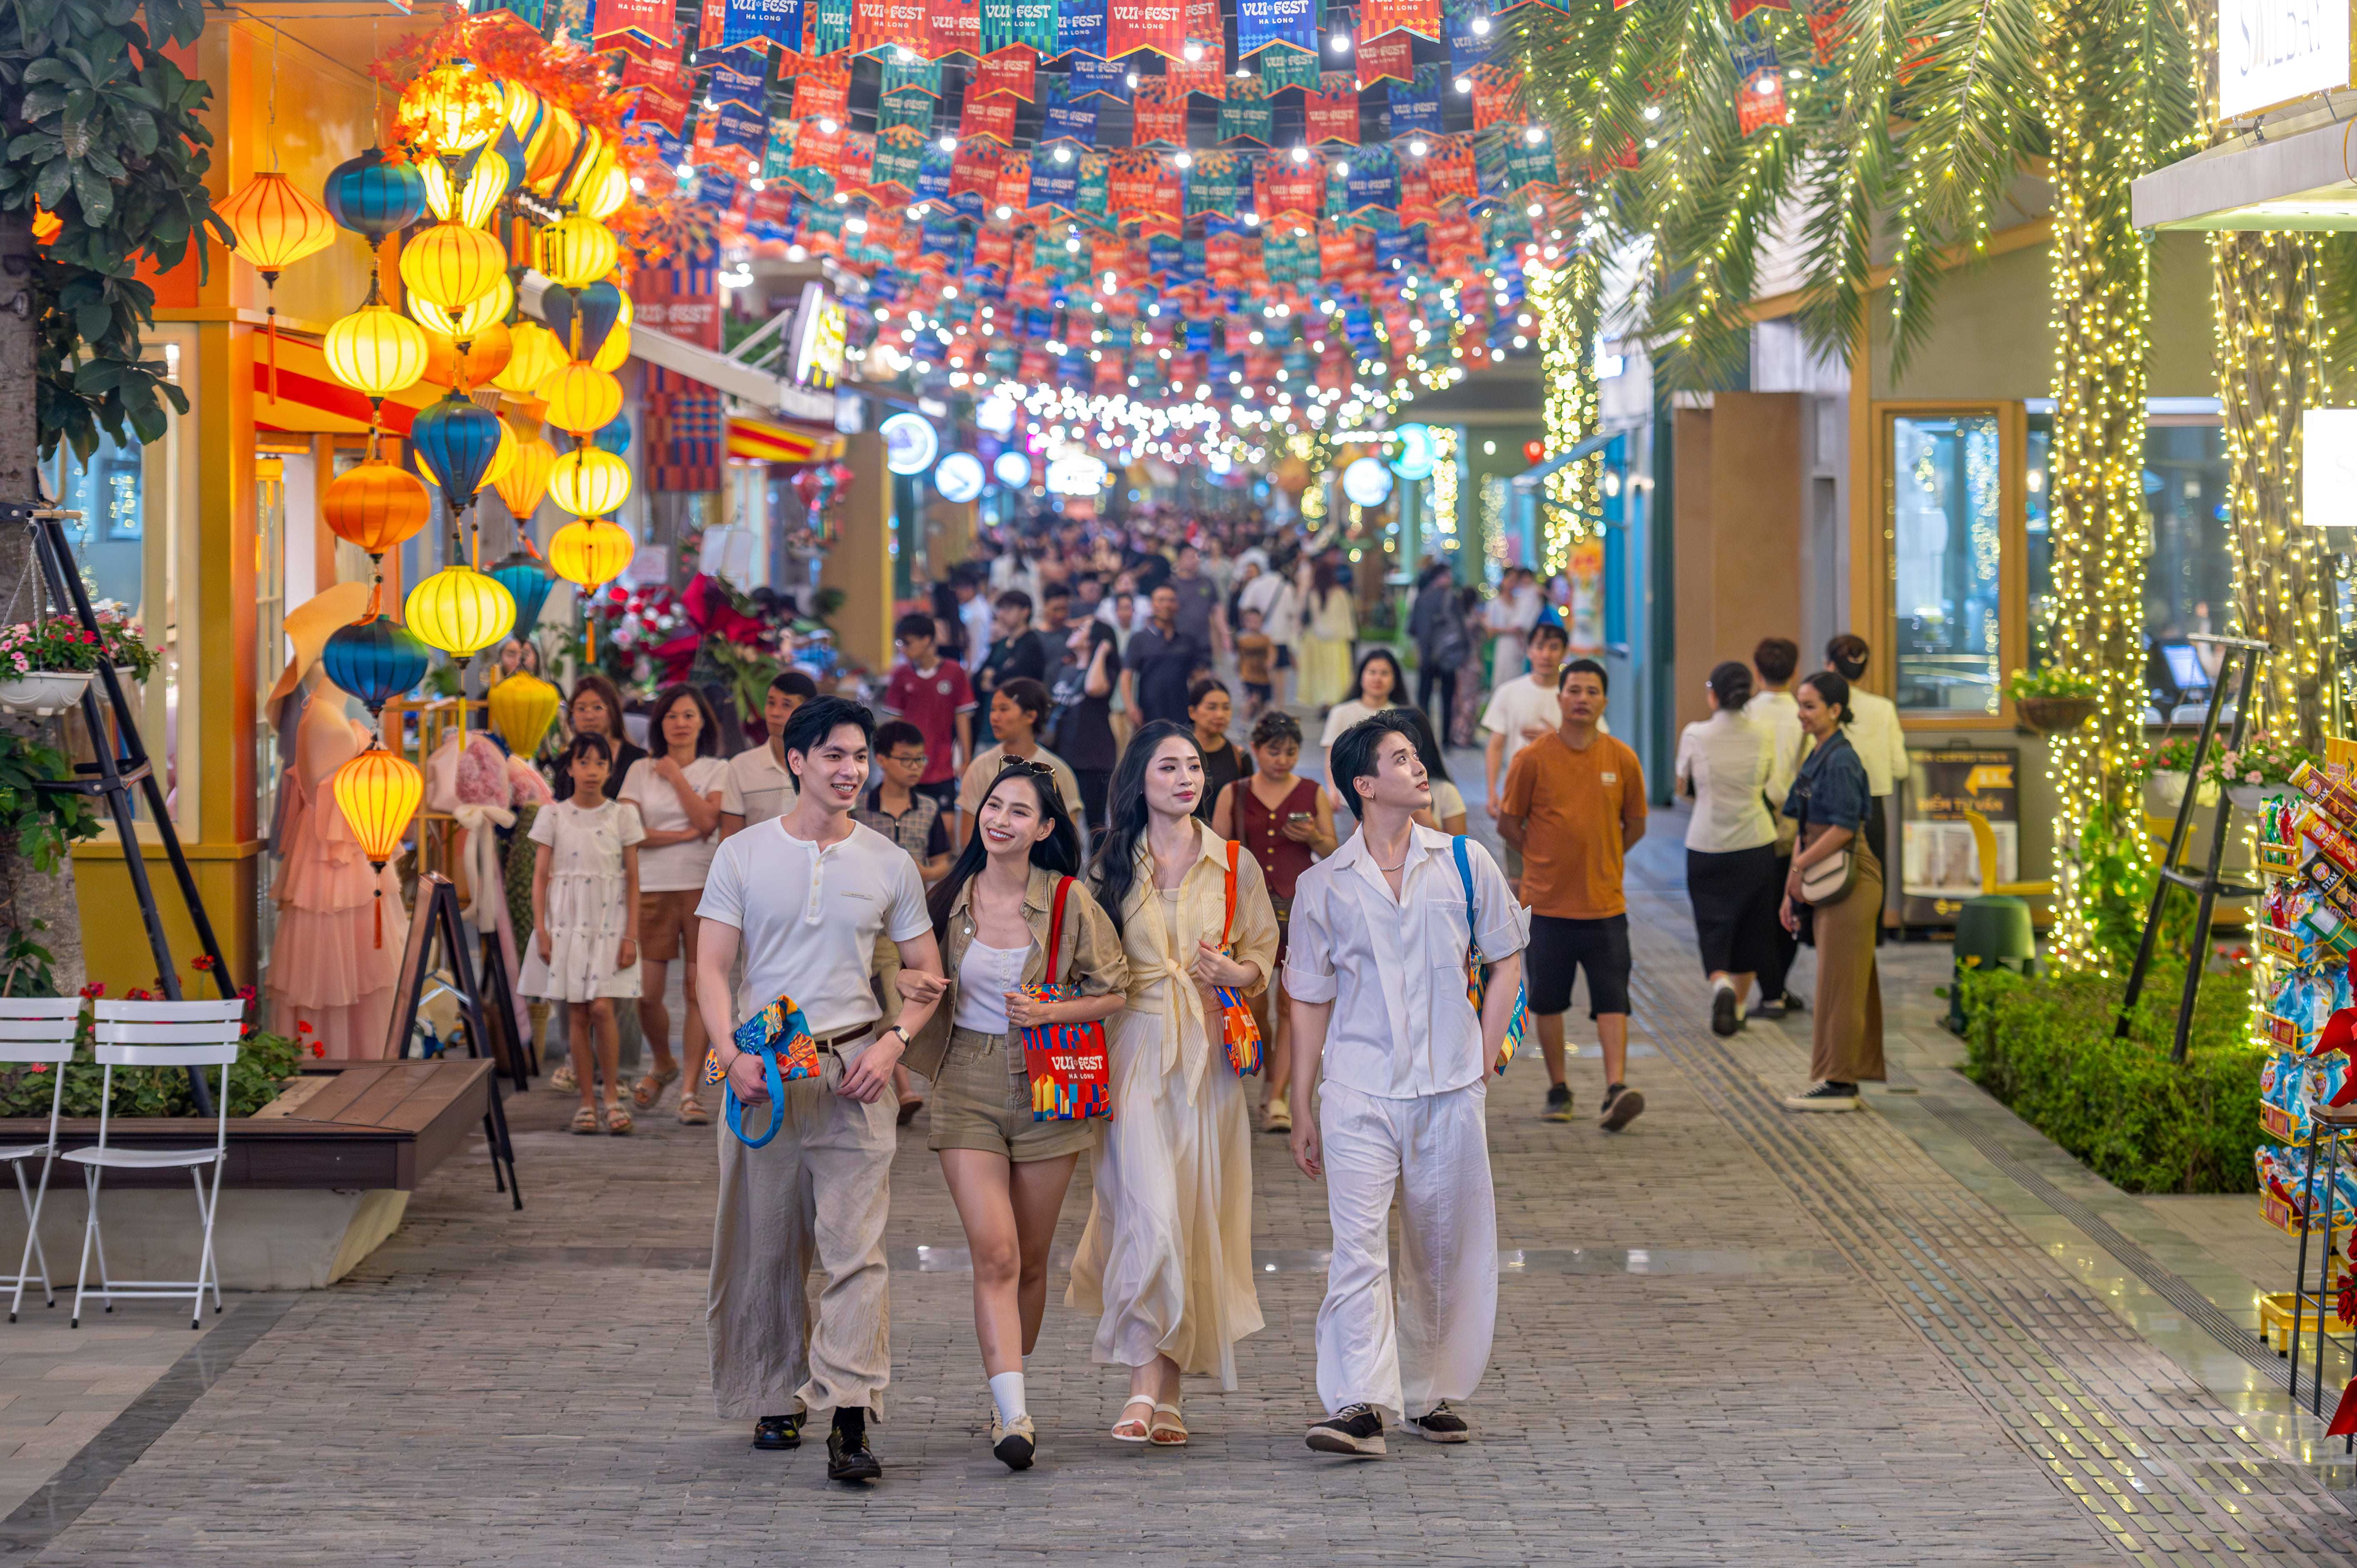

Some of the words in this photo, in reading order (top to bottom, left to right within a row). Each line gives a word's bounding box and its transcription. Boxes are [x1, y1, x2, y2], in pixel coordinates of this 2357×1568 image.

[708, 5, 725, 17] VU
[761, 0, 798, 13] FEST
[859, 3, 884, 18] VUI
[891, 6, 926, 20] FEST
[985, 5, 1010, 18] VUI
[1016, 5, 1051, 18] FEST
[1242, 2, 1267, 16] VUI
[1273, 0, 1309, 14] FEST
[821, 13, 843, 25] VUI
[1114, 7, 1138, 20] VUI
[1145, 7, 1180, 21] FEST
[931, 16, 953, 28] VUI
[958, 17, 980, 29] FES
[1072, 15, 1103, 27] FEST
[2315, 788, 2330, 803] STAX
[2322, 872, 2339, 890] STAX
[1051, 1056, 1075, 1070] VUI
[1078, 1055, 1103, 1070] FEST
